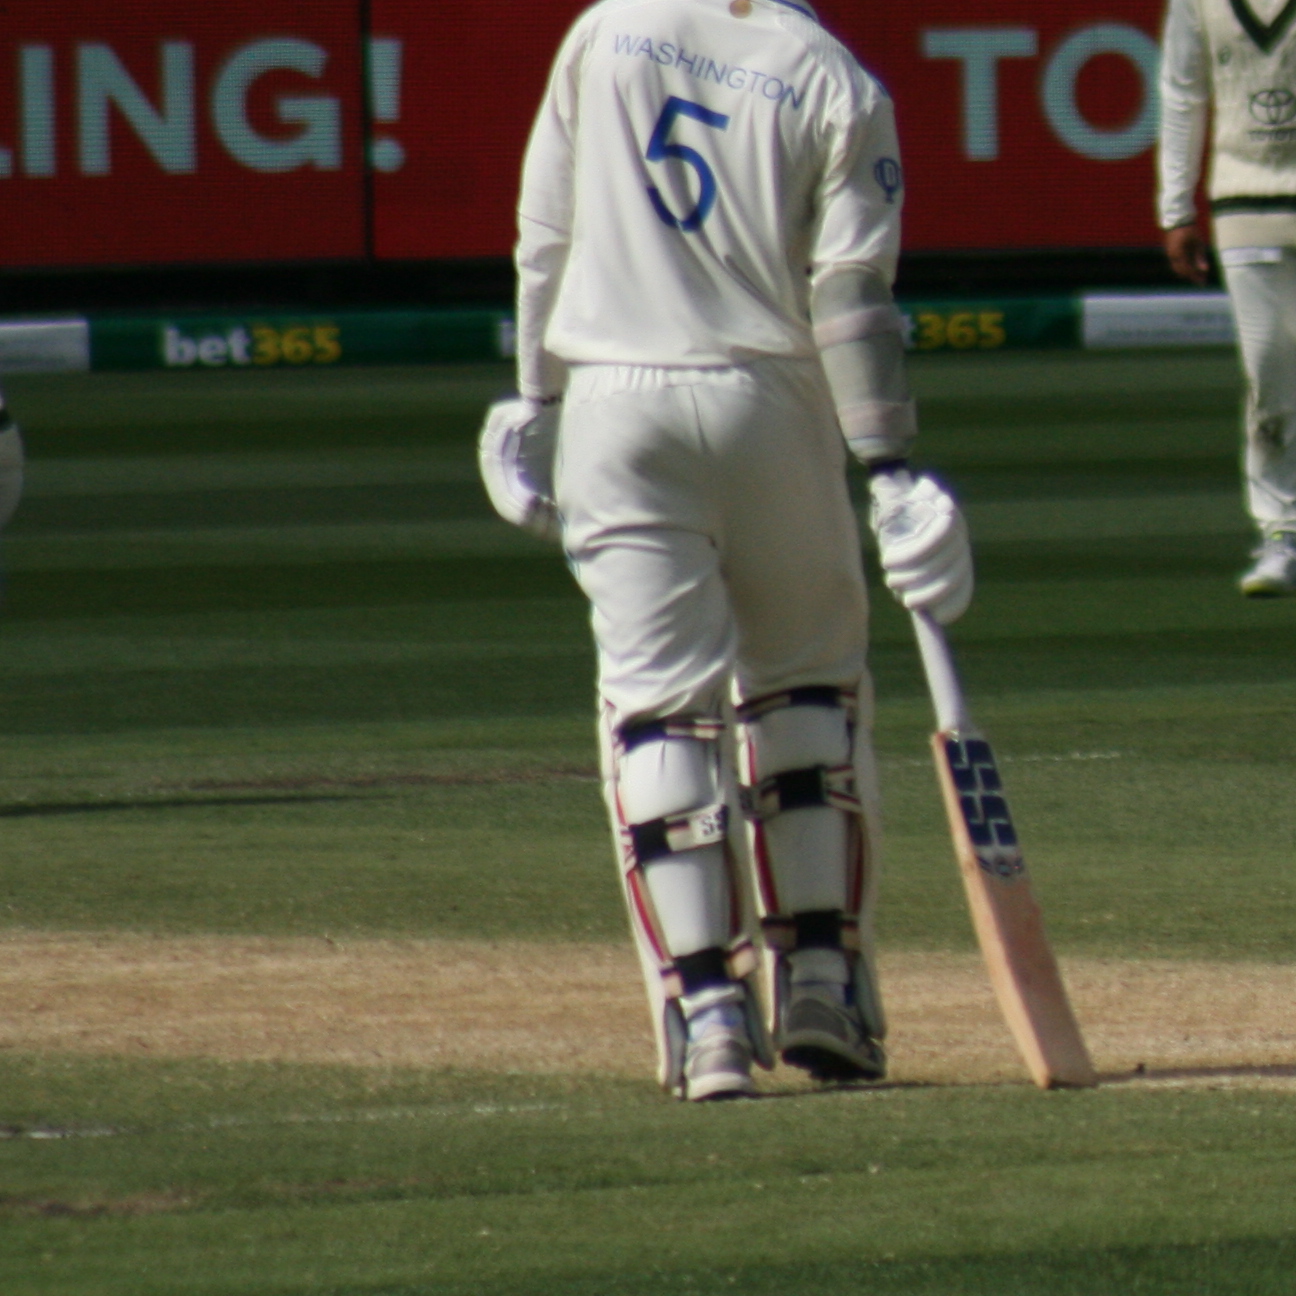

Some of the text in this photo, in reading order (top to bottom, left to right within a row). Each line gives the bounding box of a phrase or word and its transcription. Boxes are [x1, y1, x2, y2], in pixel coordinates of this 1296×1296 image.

[0, 38, 406, 178] ING!
[614, 34, 804, 109] WASHINGTON
[646, 96, 730, 232] 5
[164, 324, 341, 366] bet365
